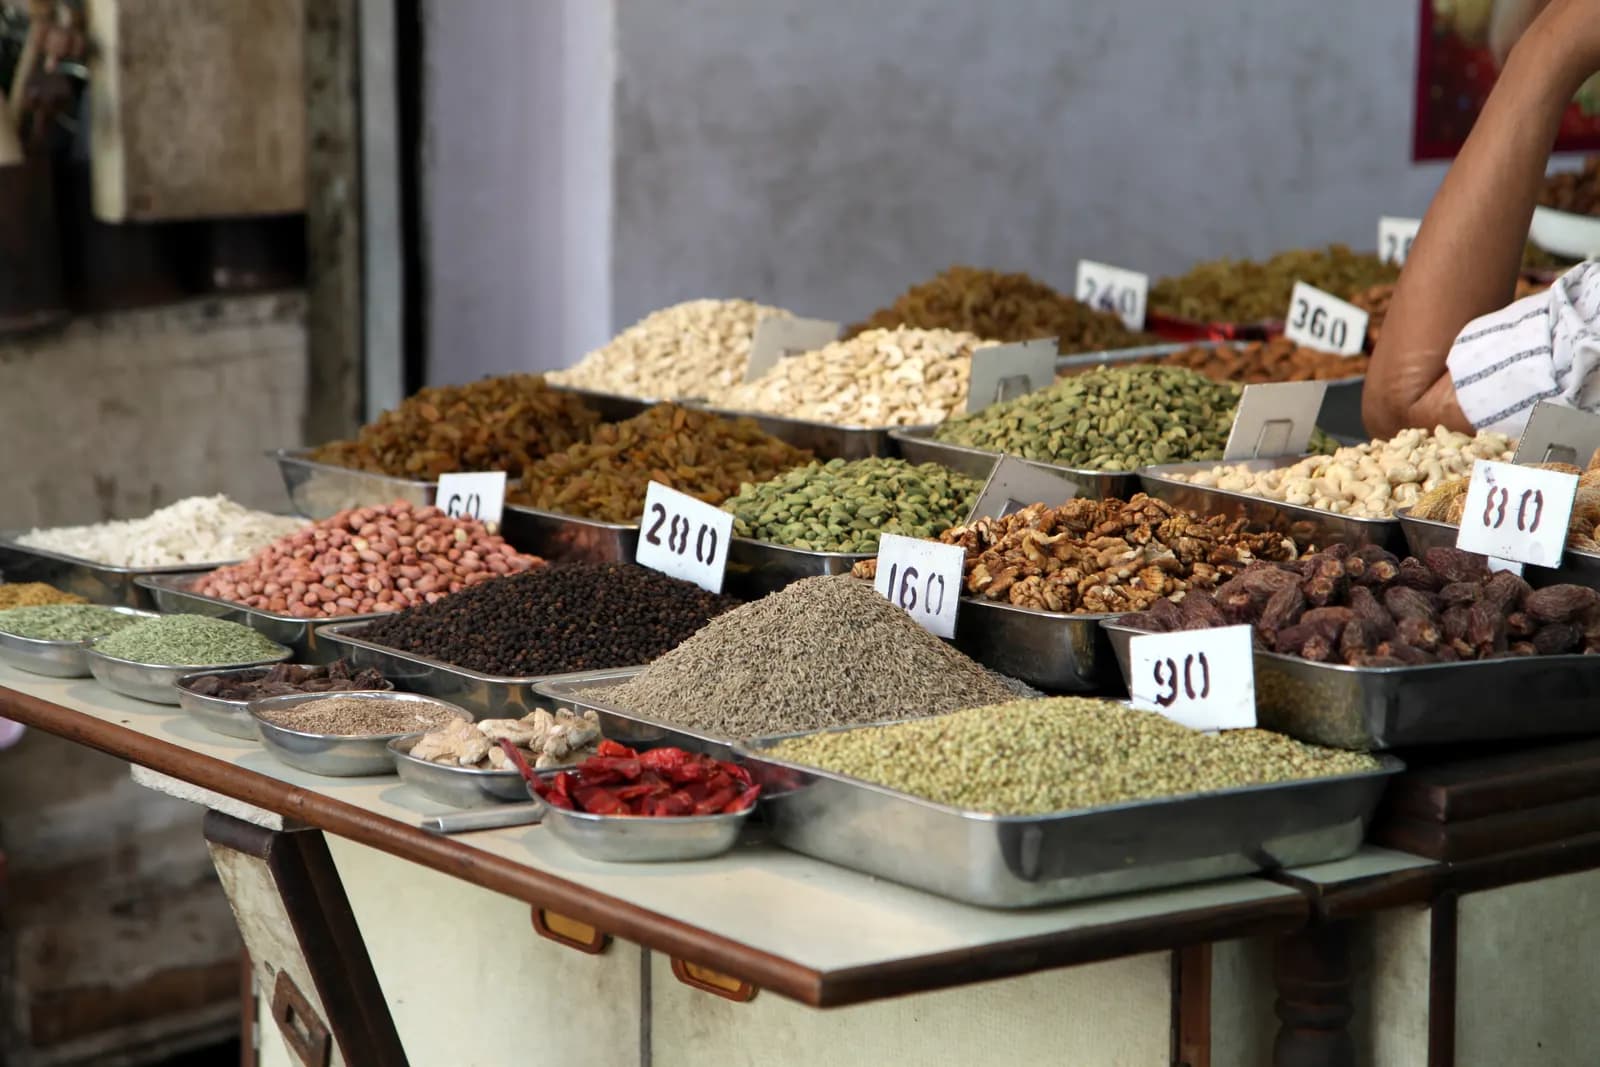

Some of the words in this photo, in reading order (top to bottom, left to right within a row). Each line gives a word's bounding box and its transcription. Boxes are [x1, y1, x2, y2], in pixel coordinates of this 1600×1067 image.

[1294, 299, 1347, 348] 360
[646, 503, 717, 566] 280
[1483, 486, 1543, 533] 80
[887, 562, 944, 616] 160
[1153, 651, 1209, 708] 90
